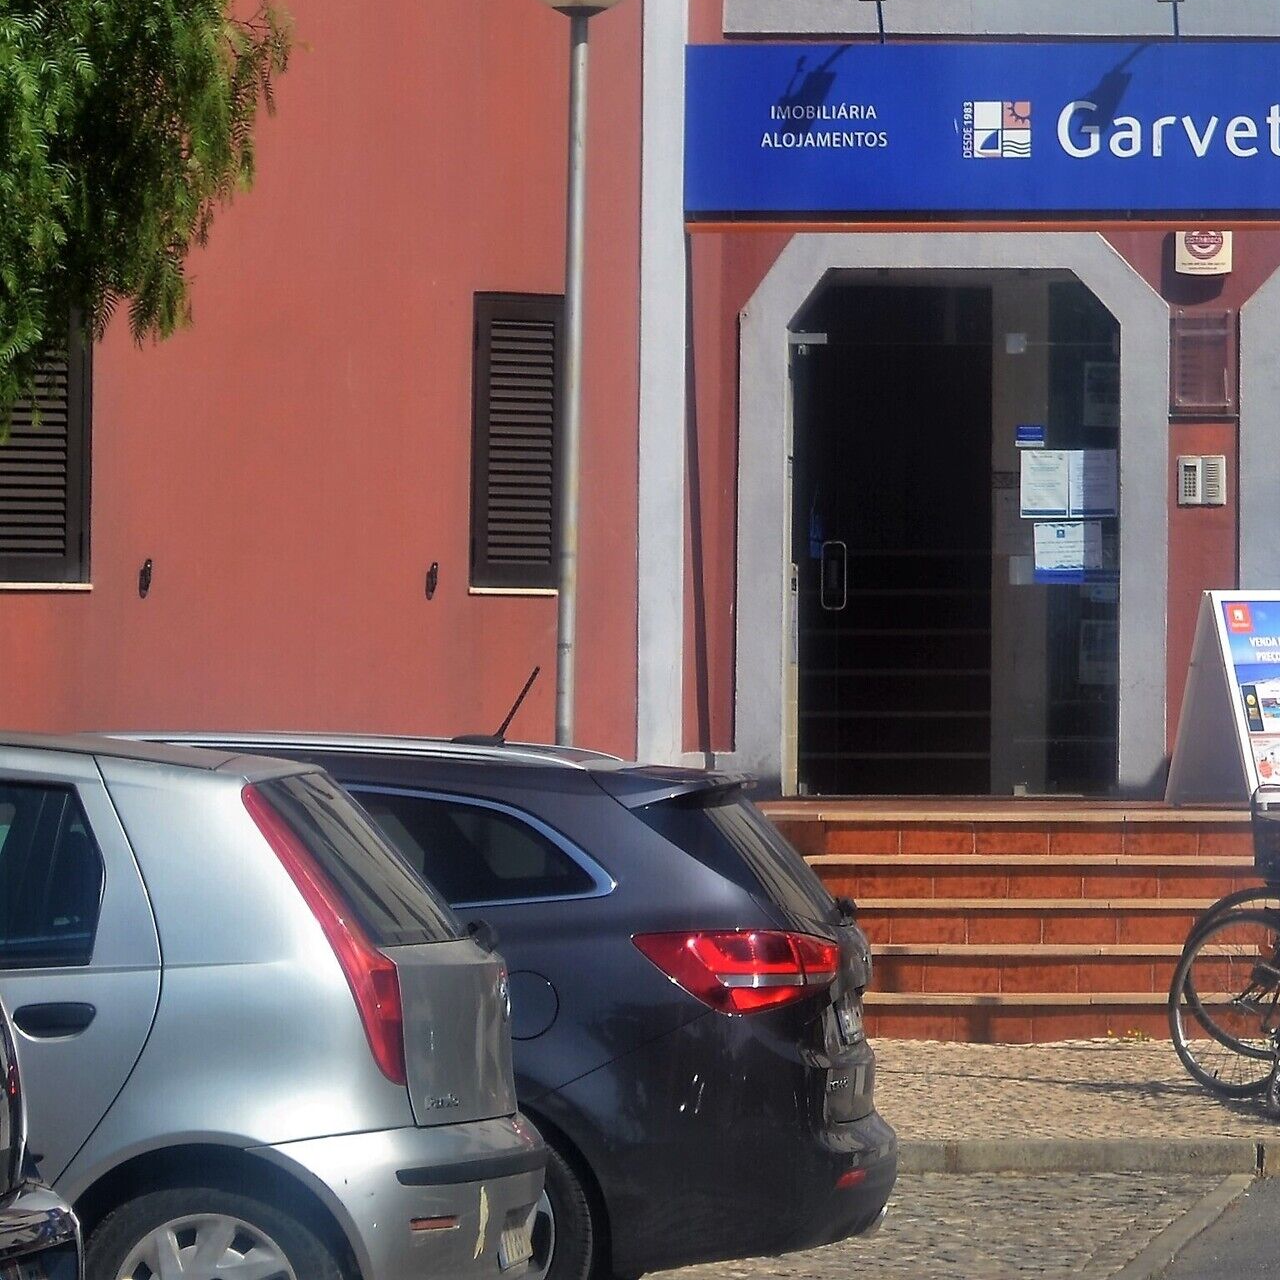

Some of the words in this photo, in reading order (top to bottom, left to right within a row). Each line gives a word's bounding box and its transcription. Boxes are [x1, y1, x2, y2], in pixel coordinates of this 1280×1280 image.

[771, 102, 877, 120] IMOBILIÁRIA
[963, 101, 973, 125] 1983
[761, 131, 888, 148] ALOJAMENTOS
[963, 127, 973, 158] DESDE
